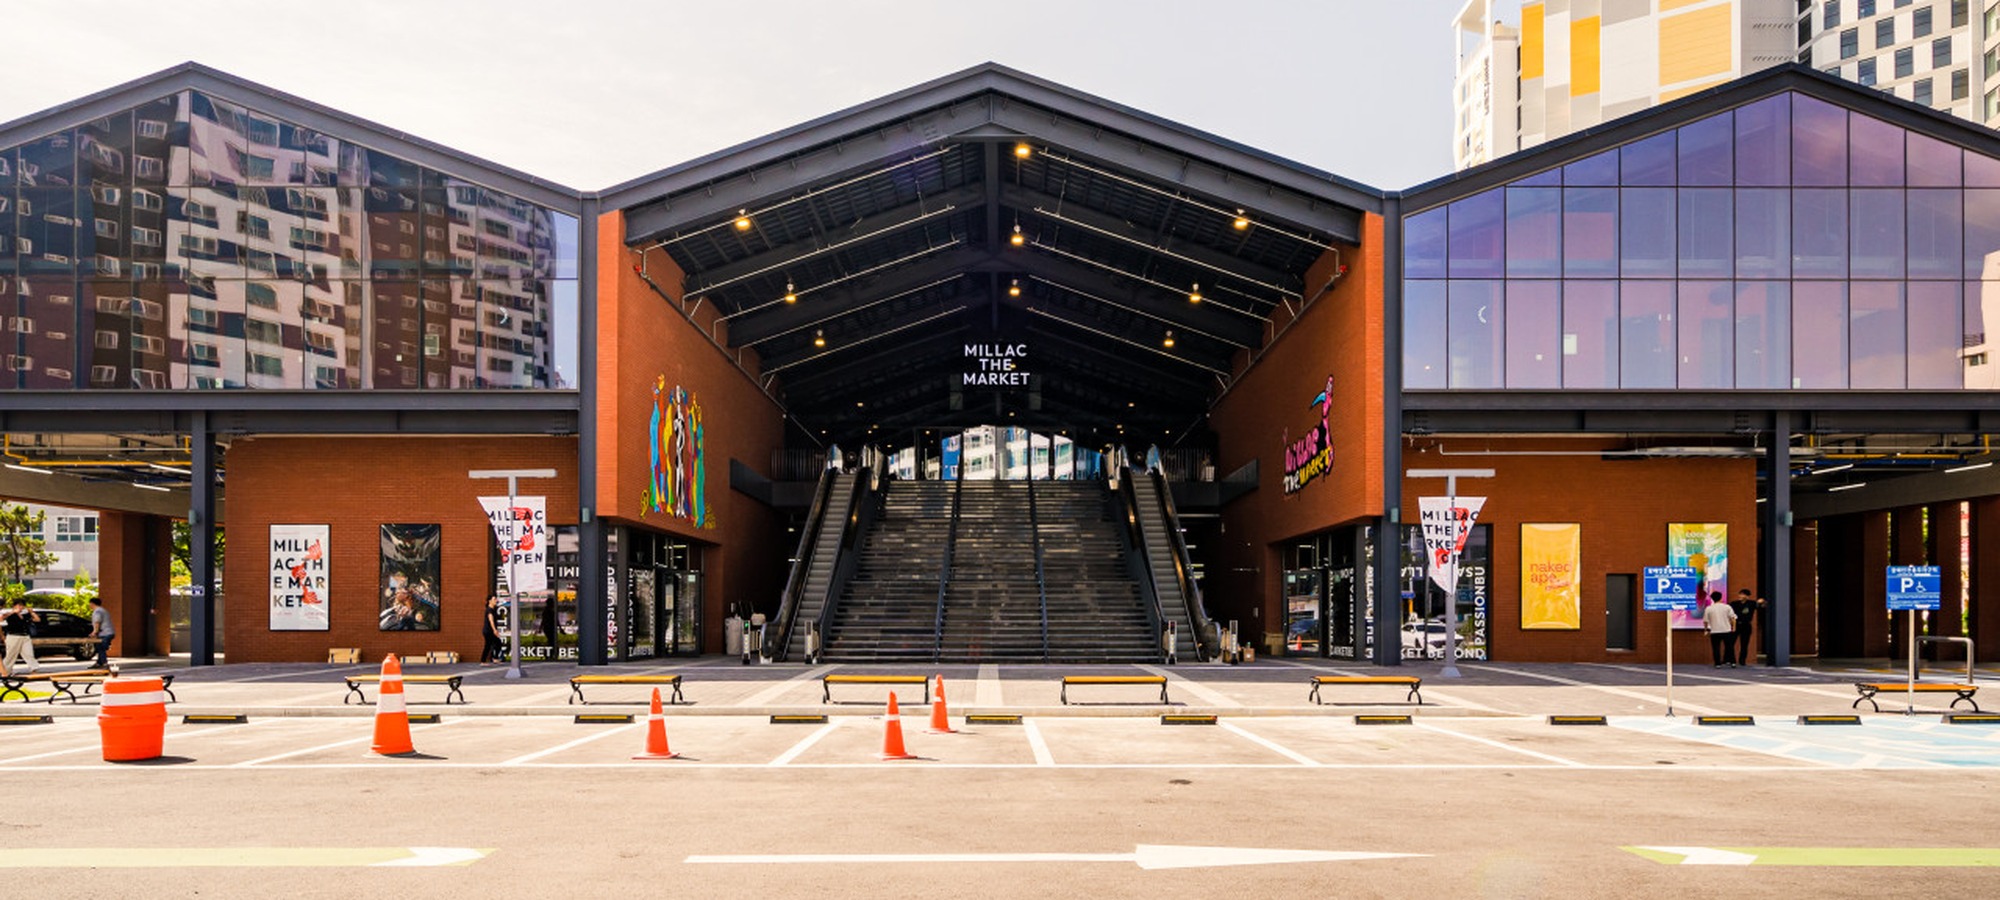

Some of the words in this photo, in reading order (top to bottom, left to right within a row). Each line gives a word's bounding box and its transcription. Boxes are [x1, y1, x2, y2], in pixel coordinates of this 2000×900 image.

[964, 343, 1027, 357] MILLAC
[978, 358, 1012, 371] THE
[963, 372, 1030, 385] MARKET
[1424, 525, 1451, 535] THE
[273, 539, 309, 552] MILL
[273, 557, 295, 570] AC
[273, 576, 283, 589] E
[288, 576, 325, 589] MAR
[1657, 578, 1671, 593] P
[1901, 577, 1914, 593] P
[273, 595, 305, 607] KET
